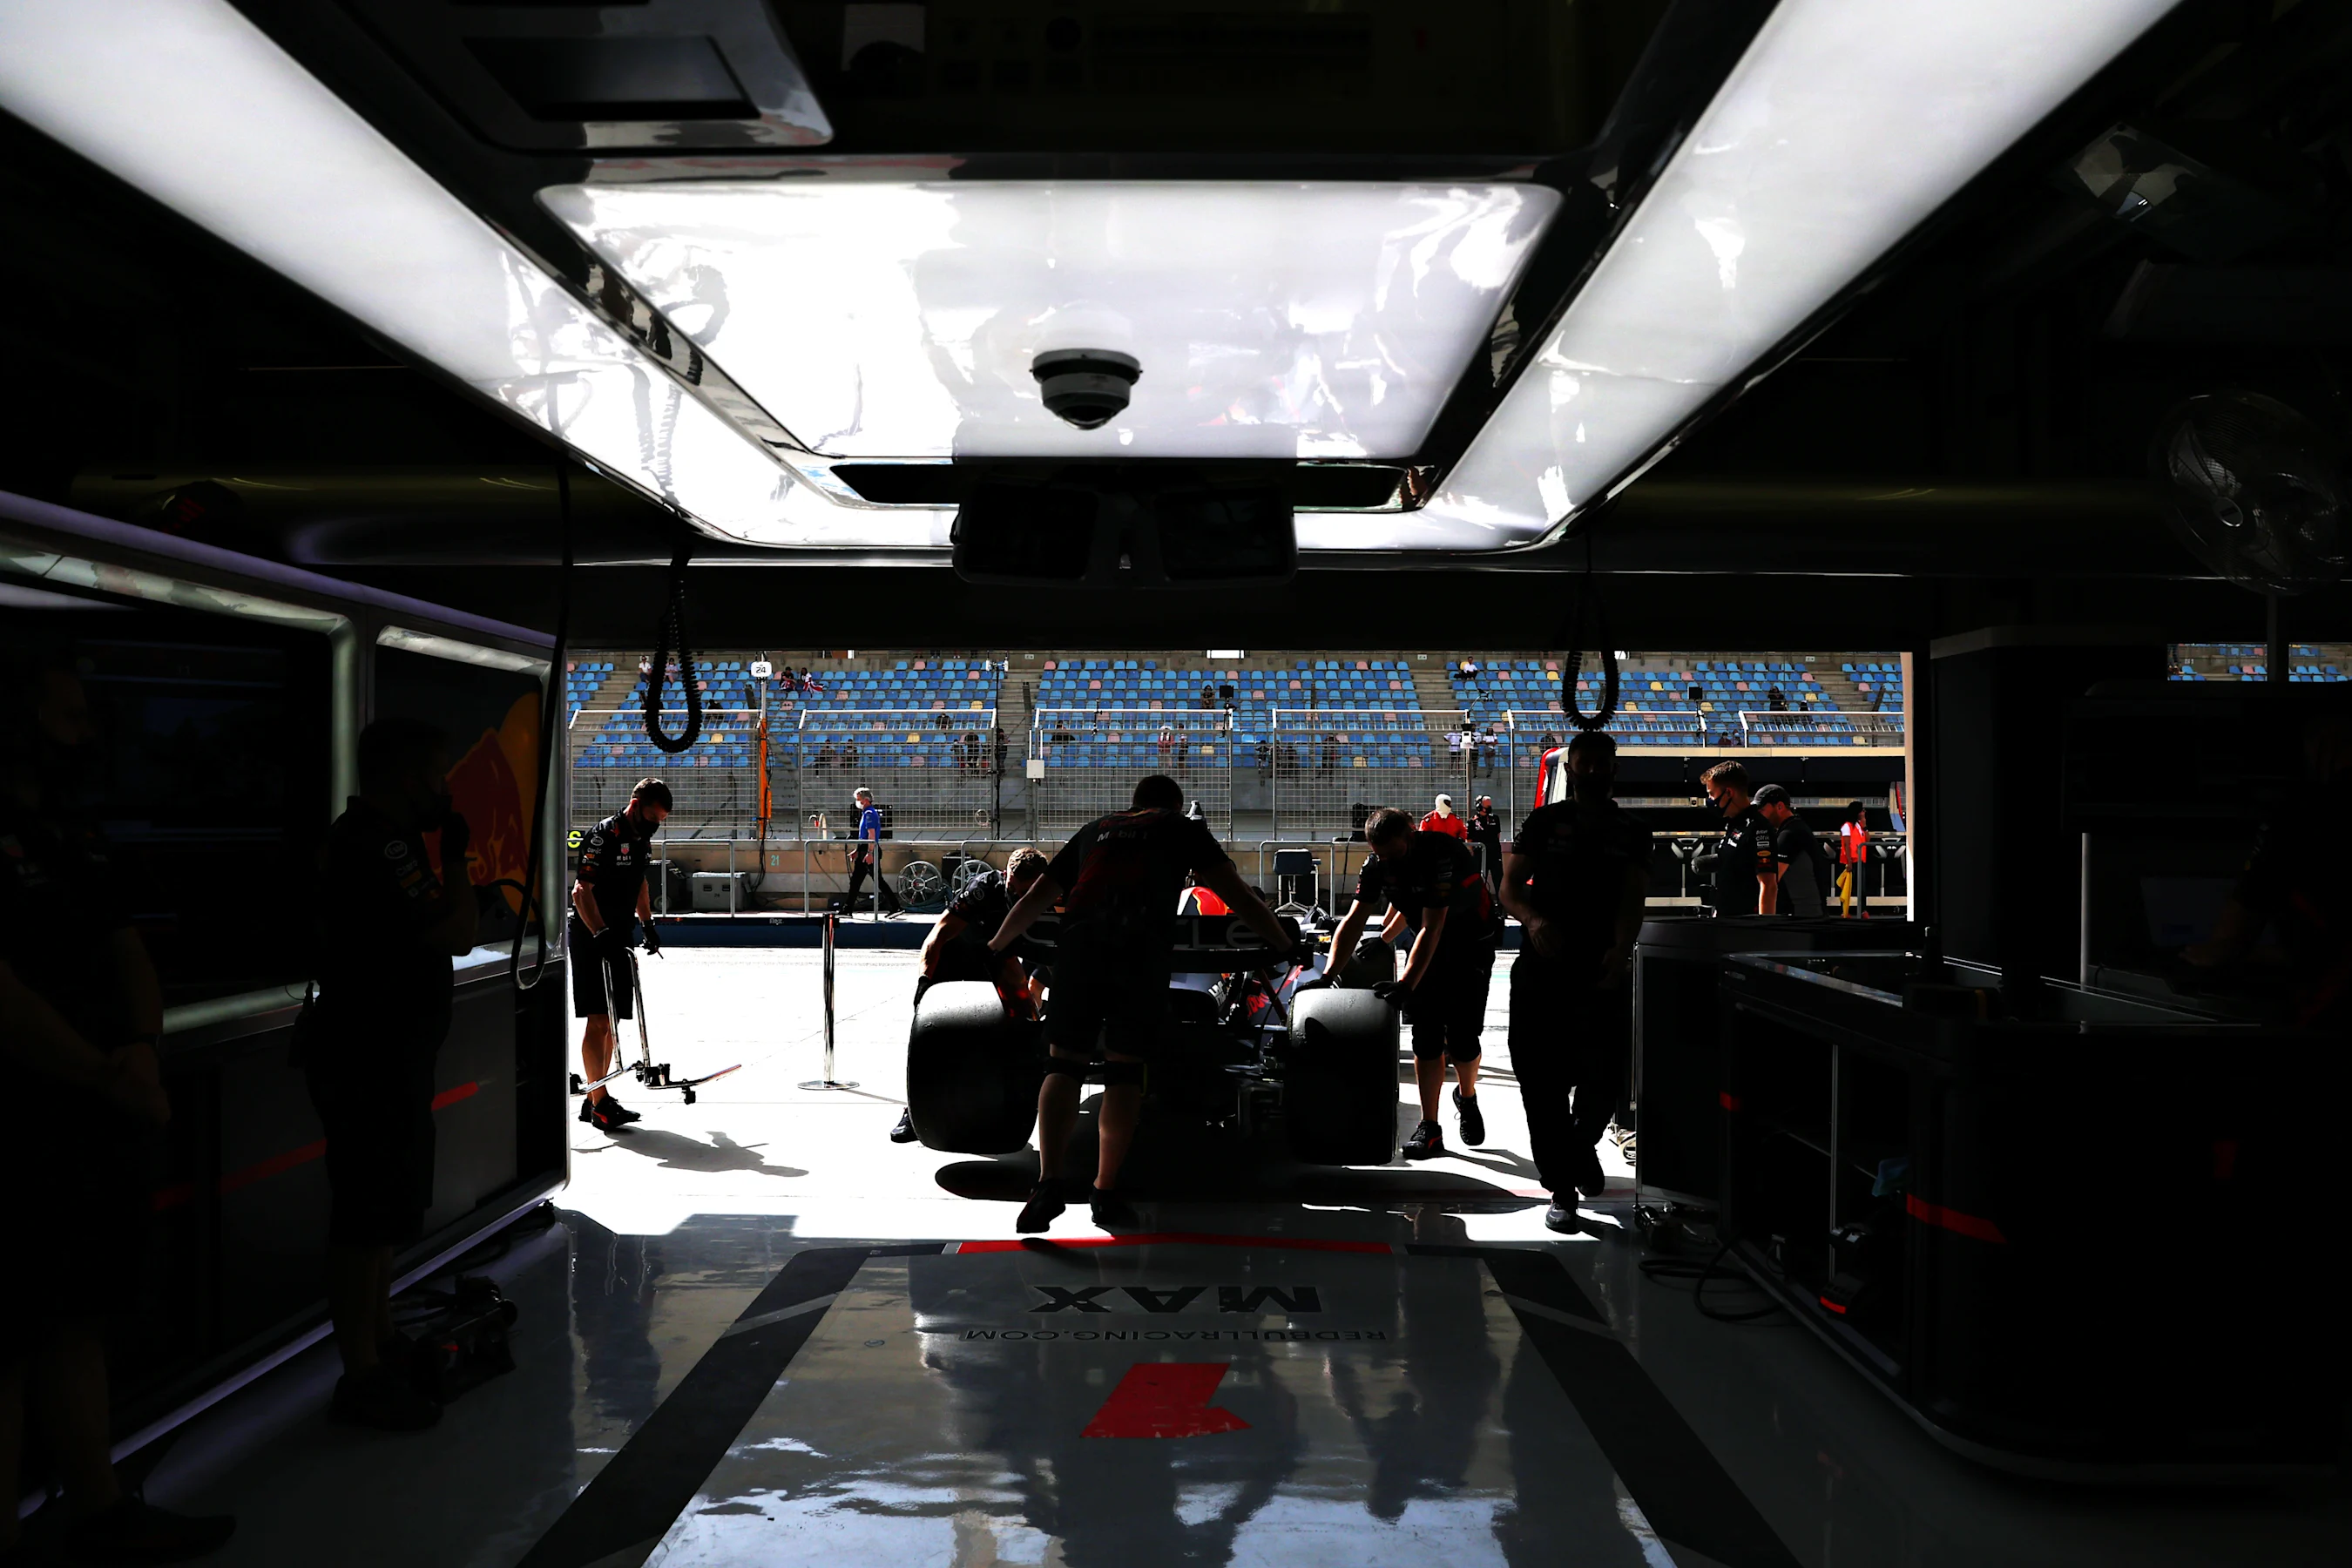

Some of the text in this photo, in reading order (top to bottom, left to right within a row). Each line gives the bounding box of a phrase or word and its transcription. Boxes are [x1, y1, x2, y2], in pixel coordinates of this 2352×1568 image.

[770, 855, 780, 867] 21
[1028, 1286, 1322, 1313] MAX
[964, 1329, 1389, 1342] REDBULLRACING.COM
